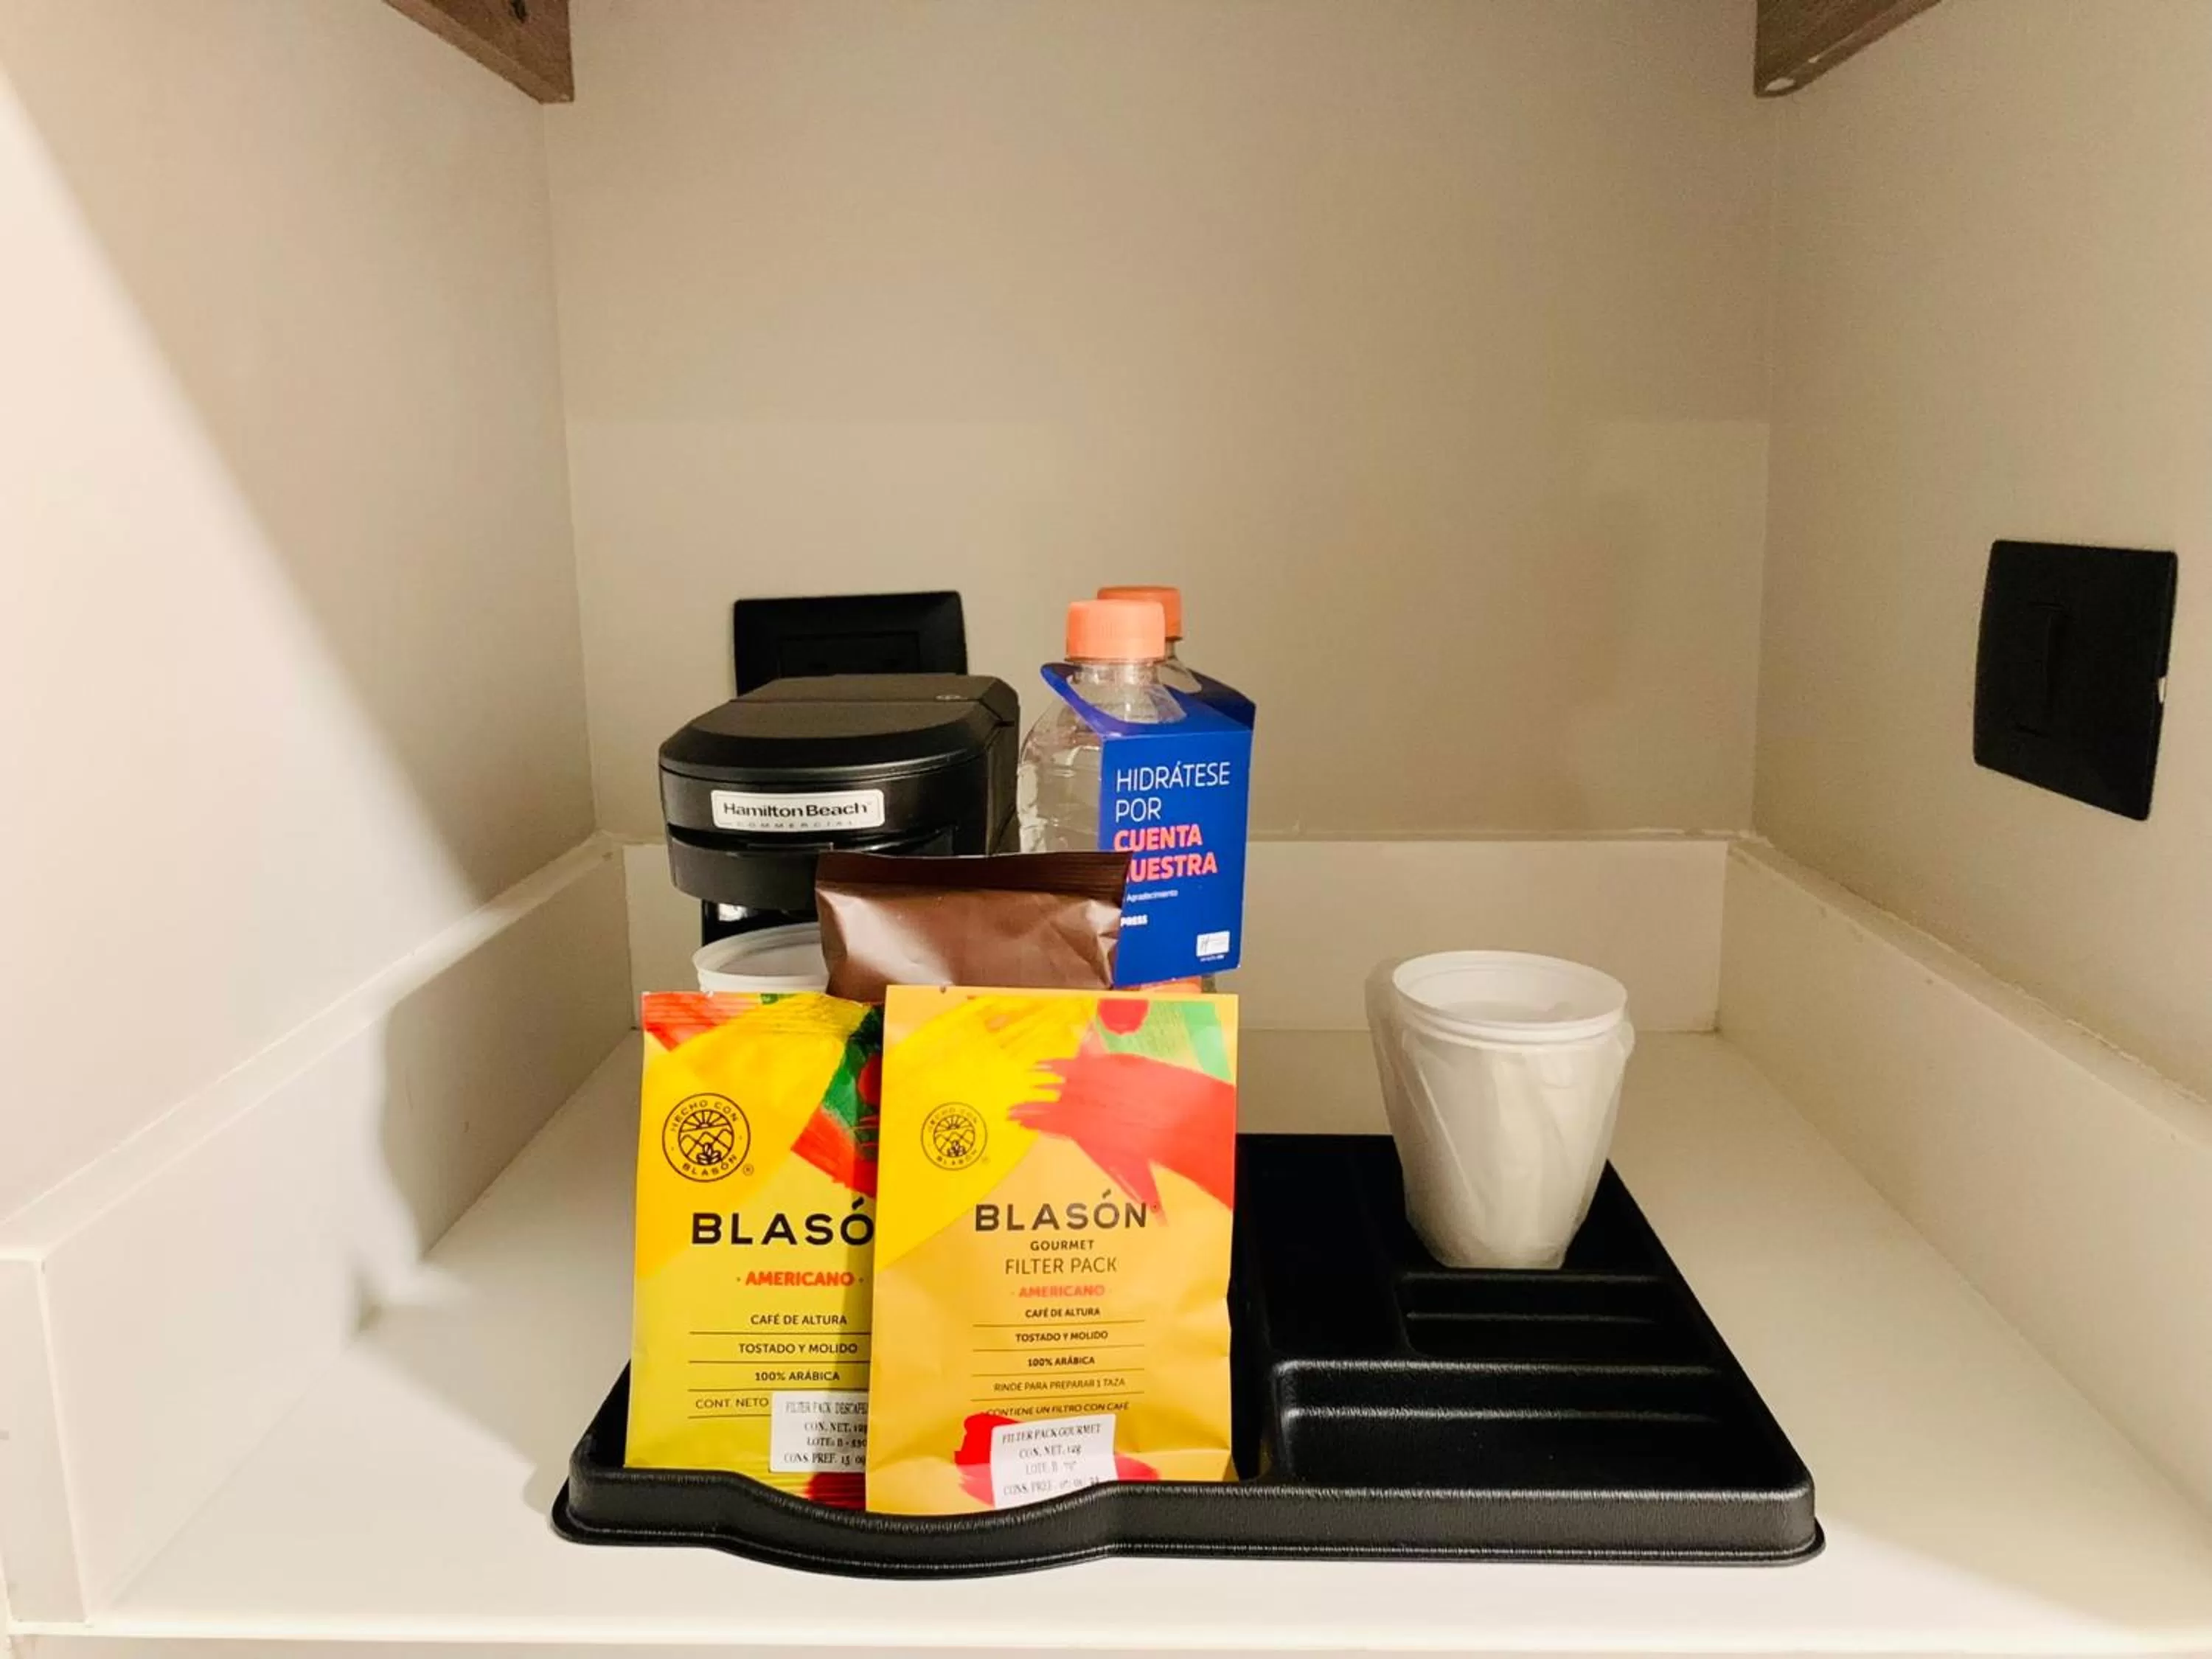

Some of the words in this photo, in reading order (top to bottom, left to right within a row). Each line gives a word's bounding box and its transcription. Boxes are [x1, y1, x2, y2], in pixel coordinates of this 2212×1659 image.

[1116, 760, 1231, 793] HIDRÁTESE
[723, 802, 804, 818] Hamilton
[806, 802, 868, 817] Beach
[1116, 797, 1161, 824] POR
[1113, 824, 1203, 852] CUENTA
[1126, 851, 1218, 883] UESTRA
[670, 1099, 709, 1132] HECHO
[714, 1101, 738, 1121] CON
[975, 1189, 1147, 1232] BLASÓN
[1029, 1239, 1095, 1251] GOURMET
[1004, 1257, 1064, 1275] FILTER
[1070, 1256, 1118, 1274] PACK
[745, 1271, 855, 1286] AMERICANO
[1018, 1284, 1105, 1298] AMERICANO
[750, 1313, 779, 1325] CAFÉ
[783, 1315, 799, 1325] DE
[801, 1315, 847, 1325] ALTURA
[1025, 1307, 1048, 1318] CAFÉ
[1051, 1309, 1062, 1318] DE
[1064, 1307, 1101, 1317] ALTURA
[1015, 1332, 1061, 1343] TOSTADO
[1063, 1332, 1069, 1341] Y
[1071, 1330, 1108, 1340] MOLIDO
[738, 1343, 796, 1354] TOSTADO
[799, 1343, 807, 1354] Y
[809, 1343, 858, 1354] MOLIDO
[1028, 1357, 1053, 1368] 100%
[1054, 1356, 1096, 1366] ARÁBICA
[755, 1371, 785, 1381] 100%
[788, 1370, 841, 1381] ARÁBICA
[994, 1381, 1023, 1392] RINDE
[1024, 1380, 1048, 1391] PARA
[1049, 1379, 1095, 1390] PREPARAR
[1103, 1377, 1125, 1387] TAZA
[735, 1397, 769, 1408] NETO
[987, 1408, 1034, 1416] CONTIENE
[1035, 1406, 1051, 1414] UN
[1107, 1402, 1130, 1411] CAFÉ
